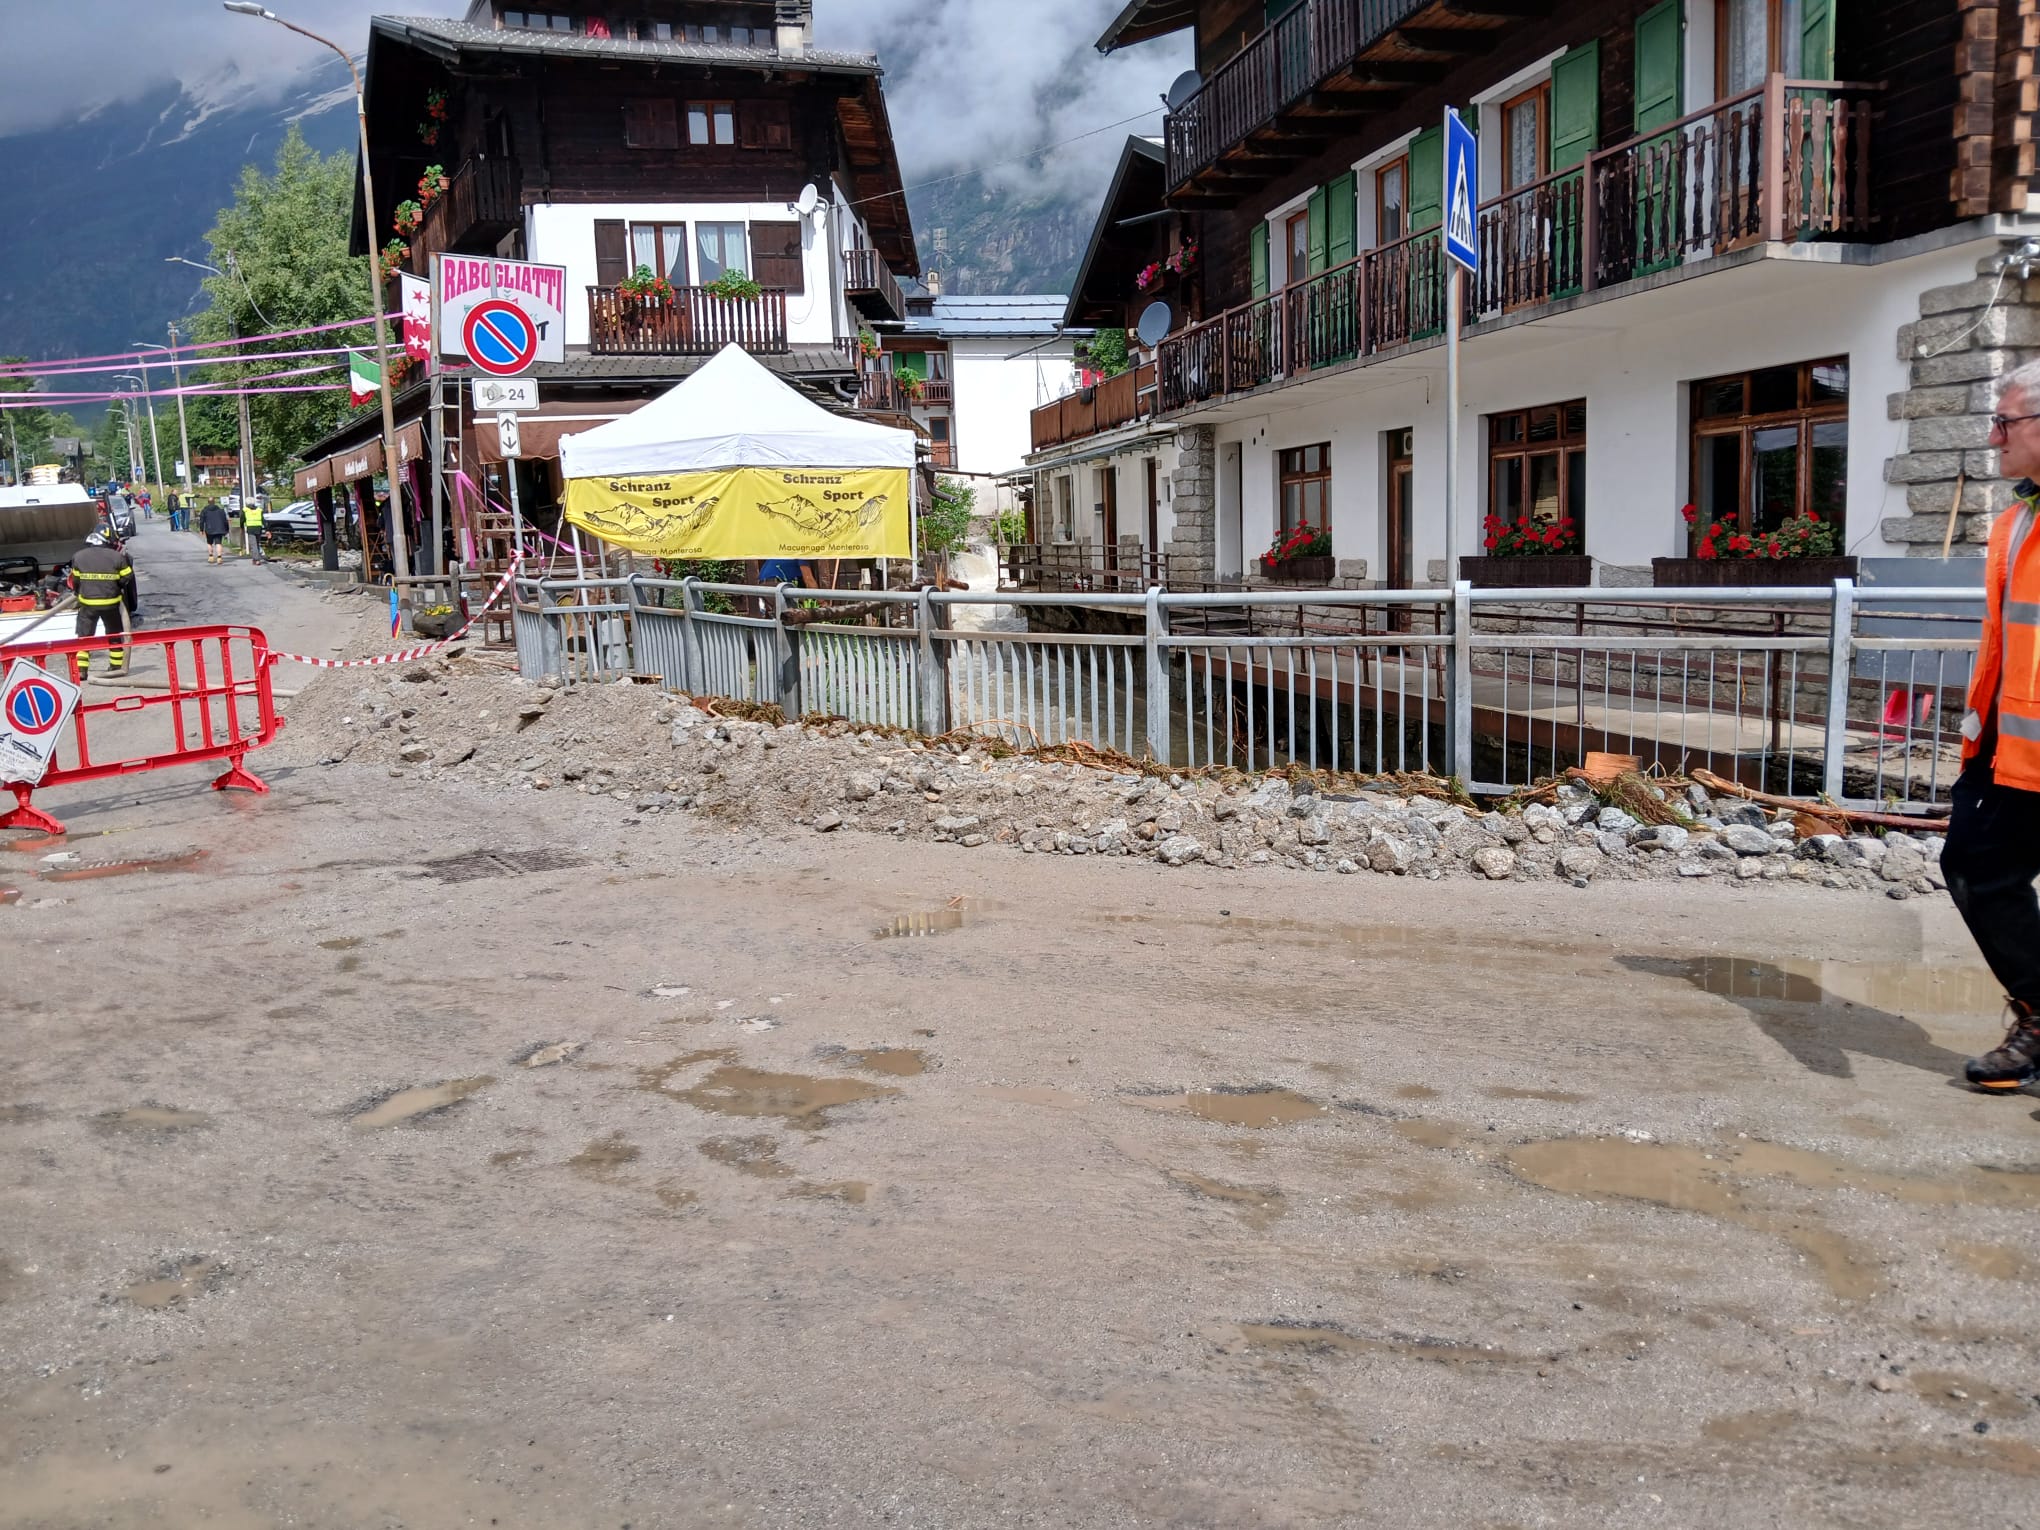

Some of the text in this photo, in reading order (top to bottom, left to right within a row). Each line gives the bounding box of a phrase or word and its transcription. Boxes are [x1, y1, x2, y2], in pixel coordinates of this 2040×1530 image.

[443, 258, 563, 315] RABOGLIATTI
[508, 388, 525, 401] 24
[782, 473, 842, 485] Schranz
[609, 481, 672, 493] Schranz
[652, 495, 695, 509] Sport
[822, 490, 864, 502] Sport
[660, 547, 703, 555] Monterosa
